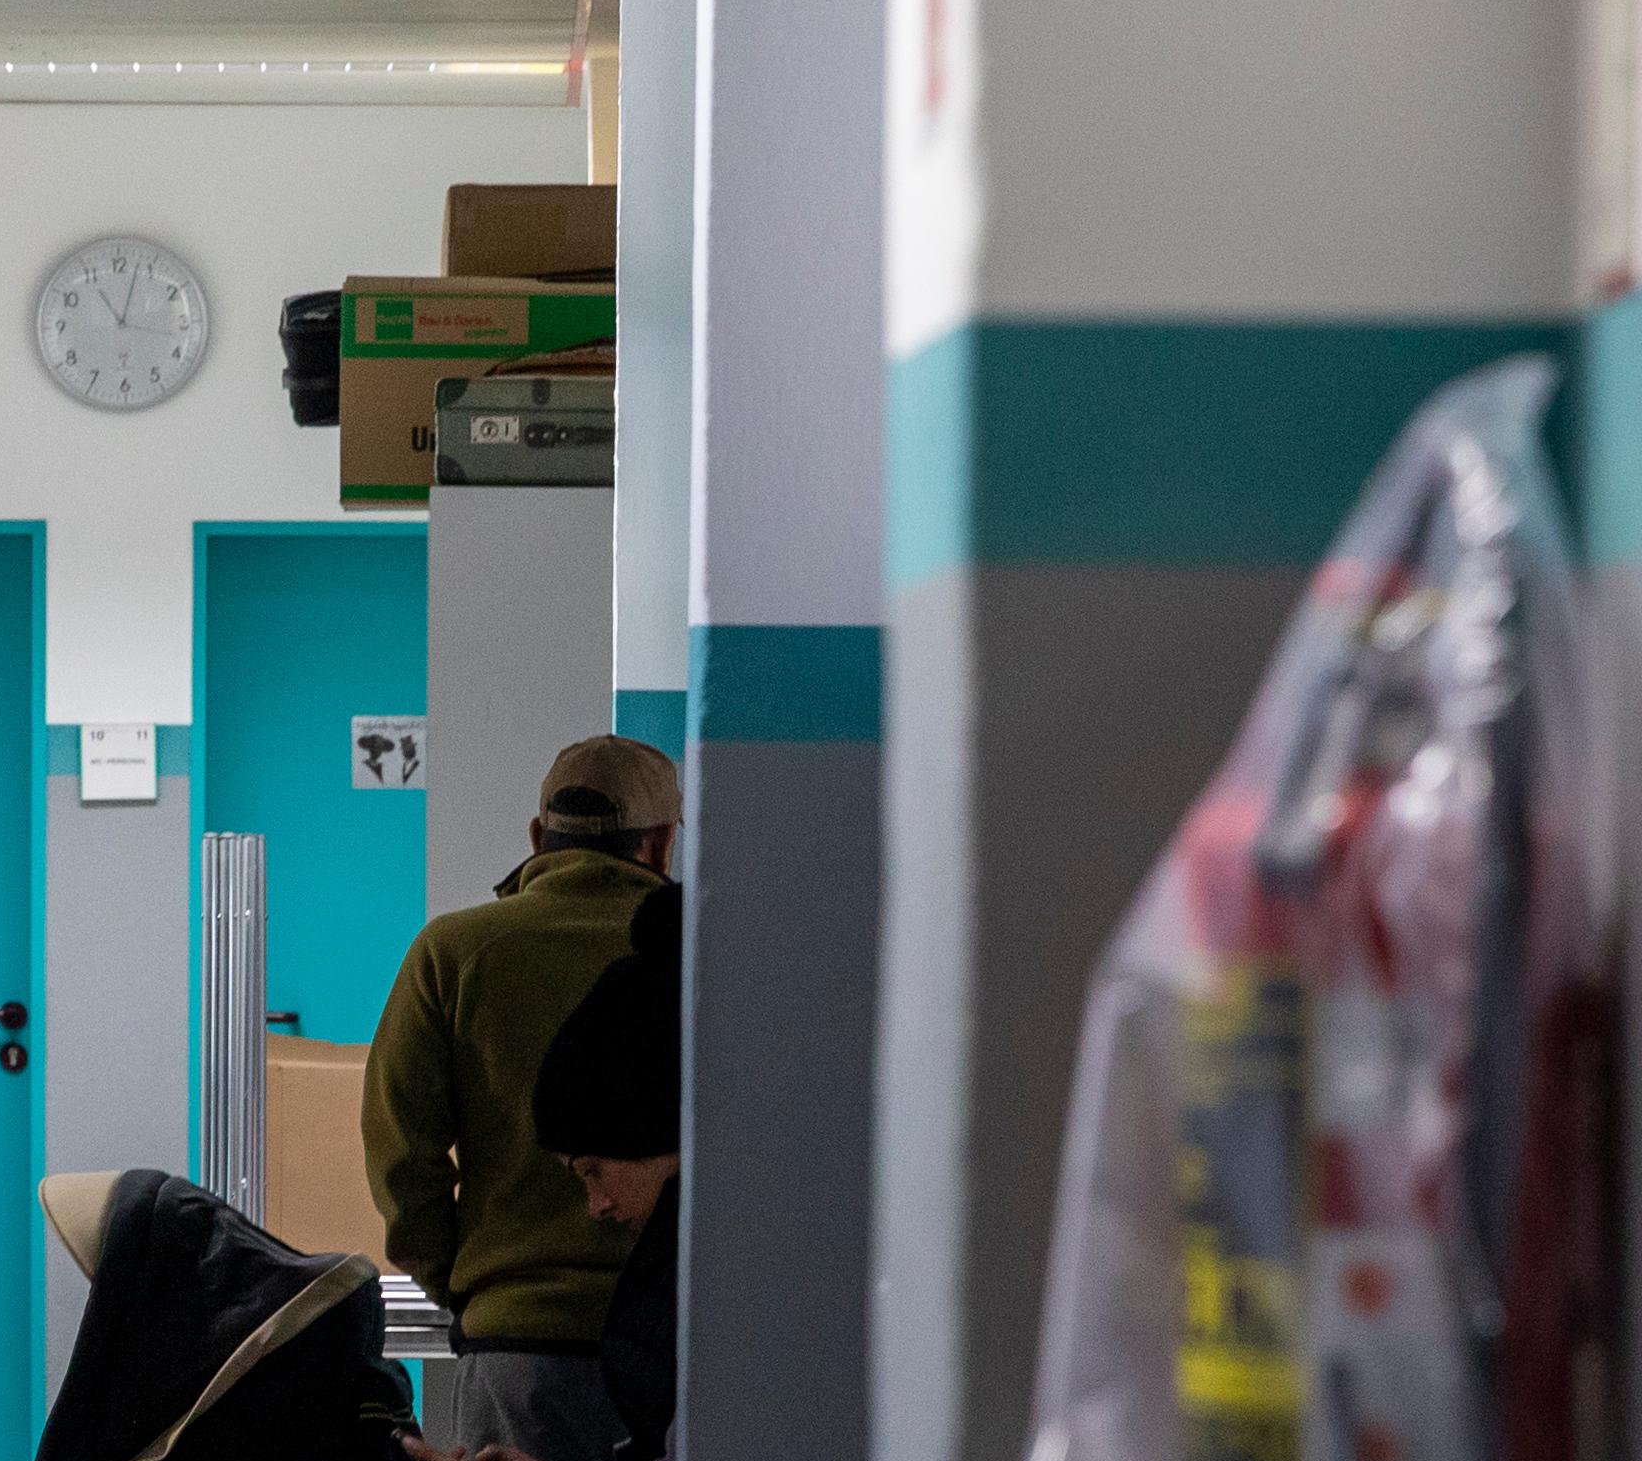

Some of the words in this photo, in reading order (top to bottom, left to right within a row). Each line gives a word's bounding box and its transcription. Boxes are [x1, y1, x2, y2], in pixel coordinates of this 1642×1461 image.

[112, 257, 127, 273] 12
[84, 268, 97, 283] 11
[63, 291, 79, 308] 10
[166, 285, 178, 301] 2
[55, 320, 66, 335] 9
[66, 350, 77, 366] 8
[171, 346, 181, 360] 4
[89, 369, 99, 386] 7
[150, 366, 160, 383] 5
[120, 378, 131, 393] 6
[91, 730, 105, 741] 10
[137, 730, 148, 741] 11
